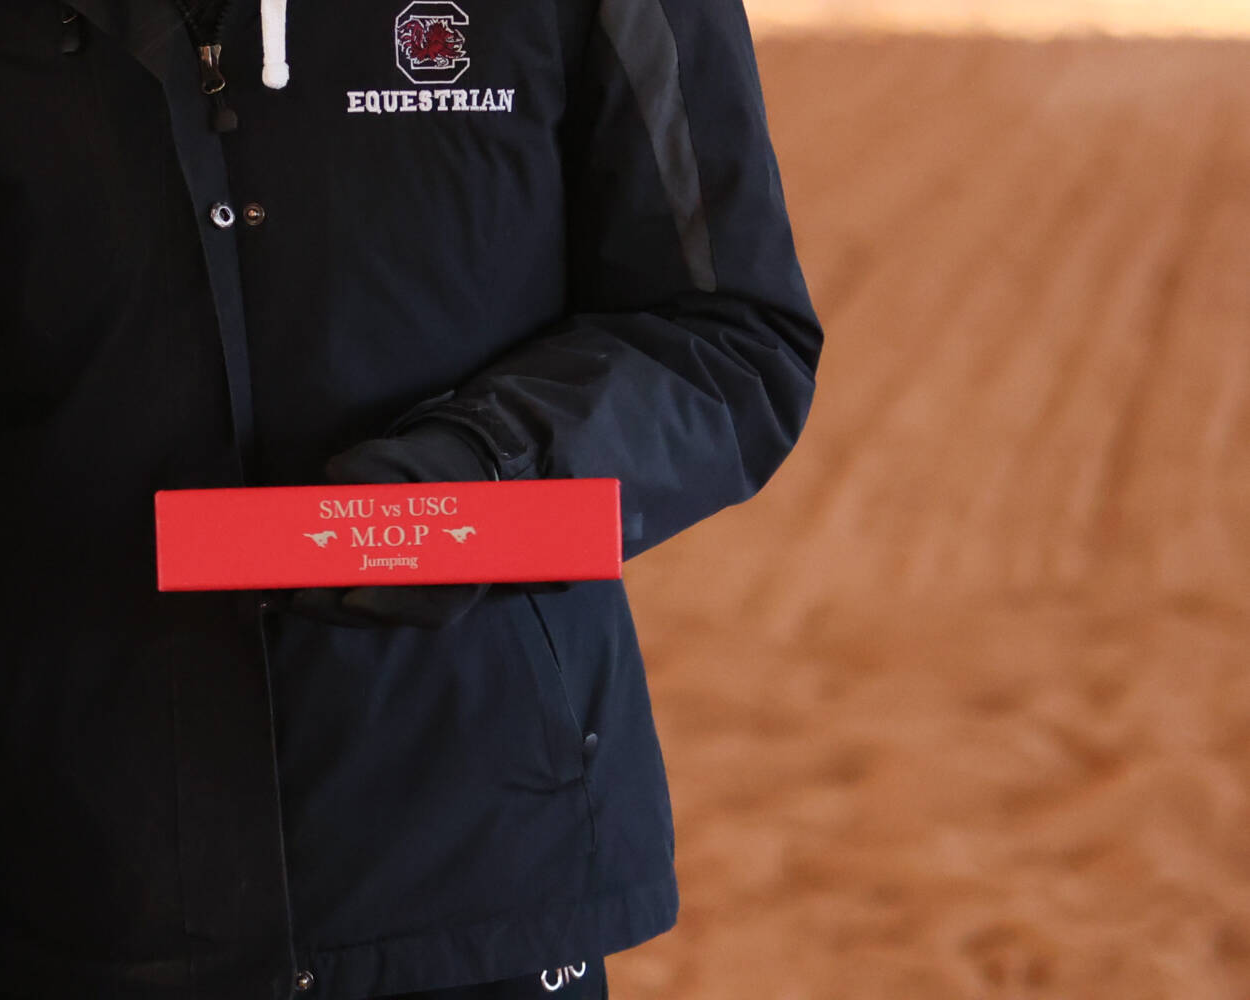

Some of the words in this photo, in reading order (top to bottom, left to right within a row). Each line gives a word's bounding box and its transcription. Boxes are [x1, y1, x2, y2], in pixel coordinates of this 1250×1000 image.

[346, 87, 516, 115] EQUESTRIAN
[318, 498, 375, 520] SMU
[380, 504, 402, 518] vs
[407, 496, 458, 517] USC
[350, 524, 430, 548] M.O.P
[358, 553, 419, 571] Jumping
